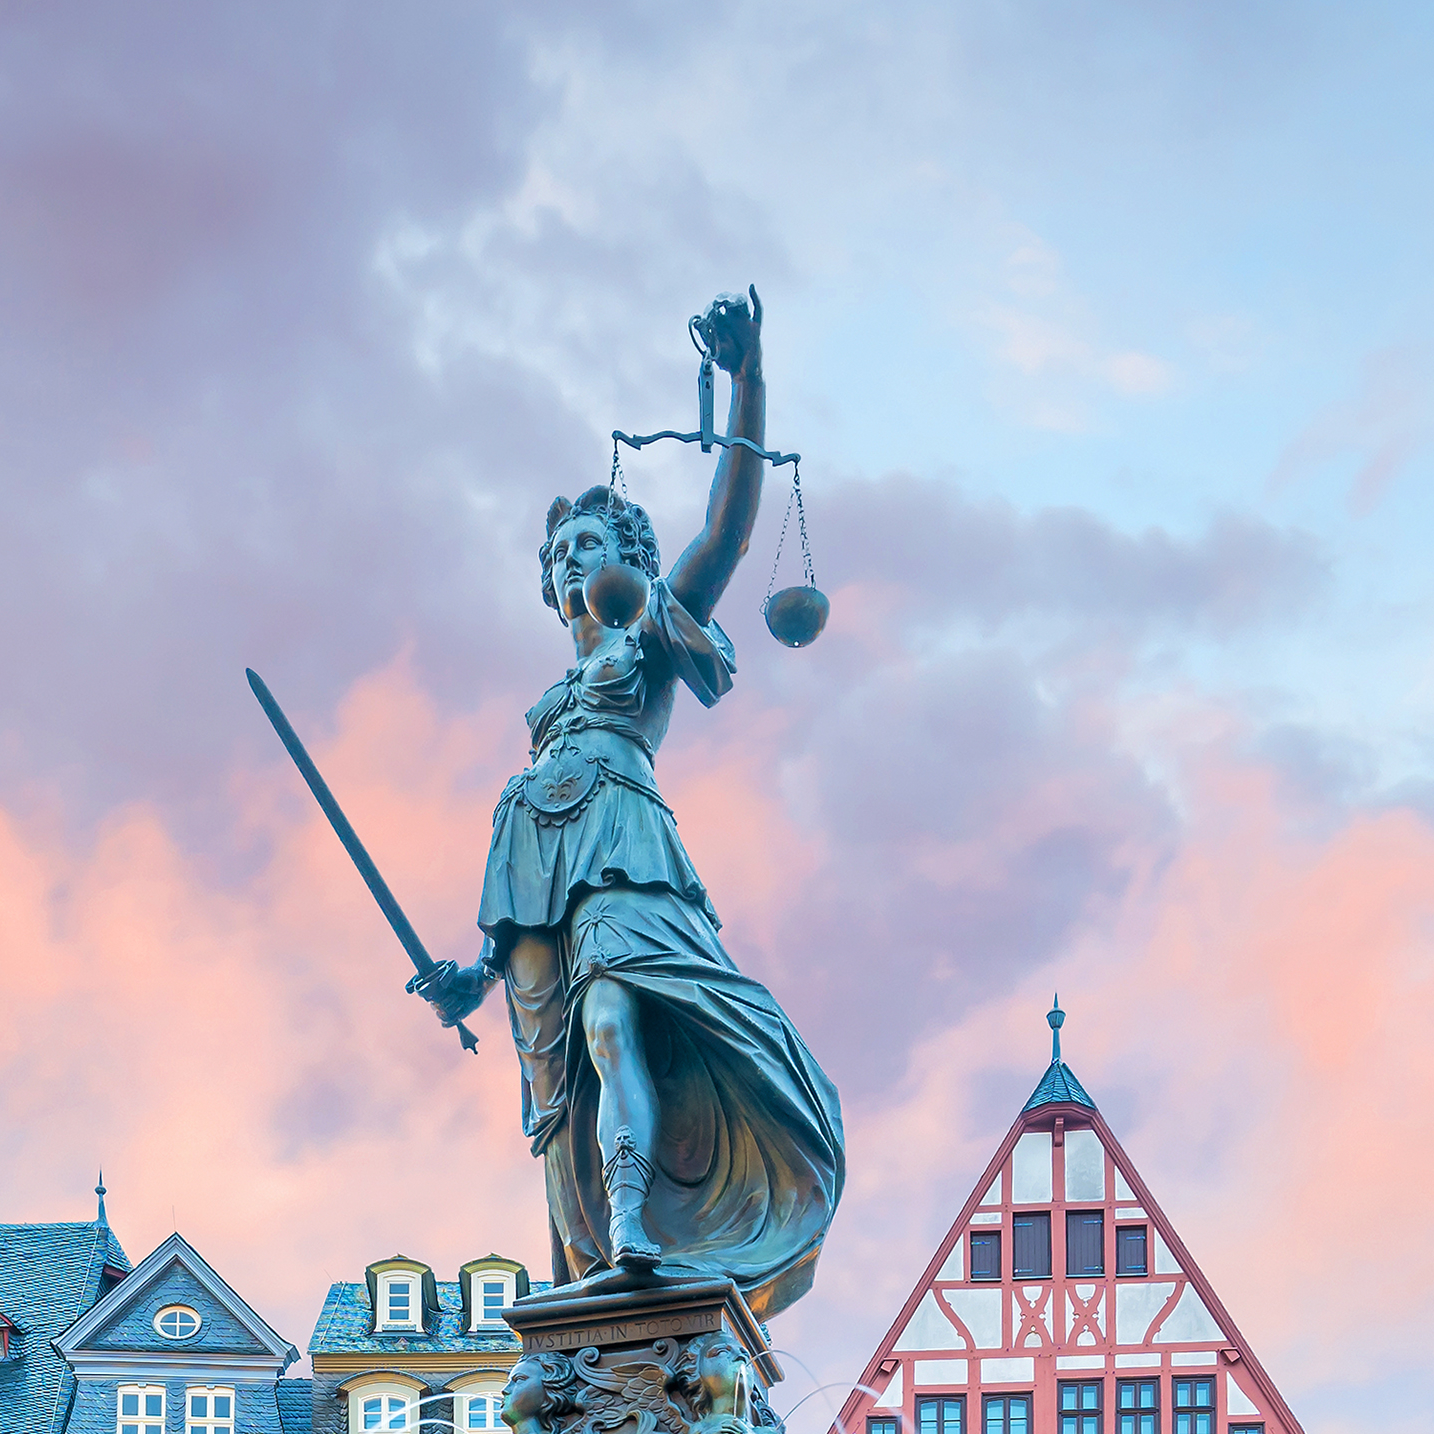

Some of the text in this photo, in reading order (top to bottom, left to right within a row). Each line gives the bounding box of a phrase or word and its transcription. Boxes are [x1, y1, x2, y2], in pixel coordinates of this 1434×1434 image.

[529, 1329, 603, 1349] IVSTITIA
[610, 1325, 628, 1340] IN
[635, 1318, 682, 1335] TOTO
